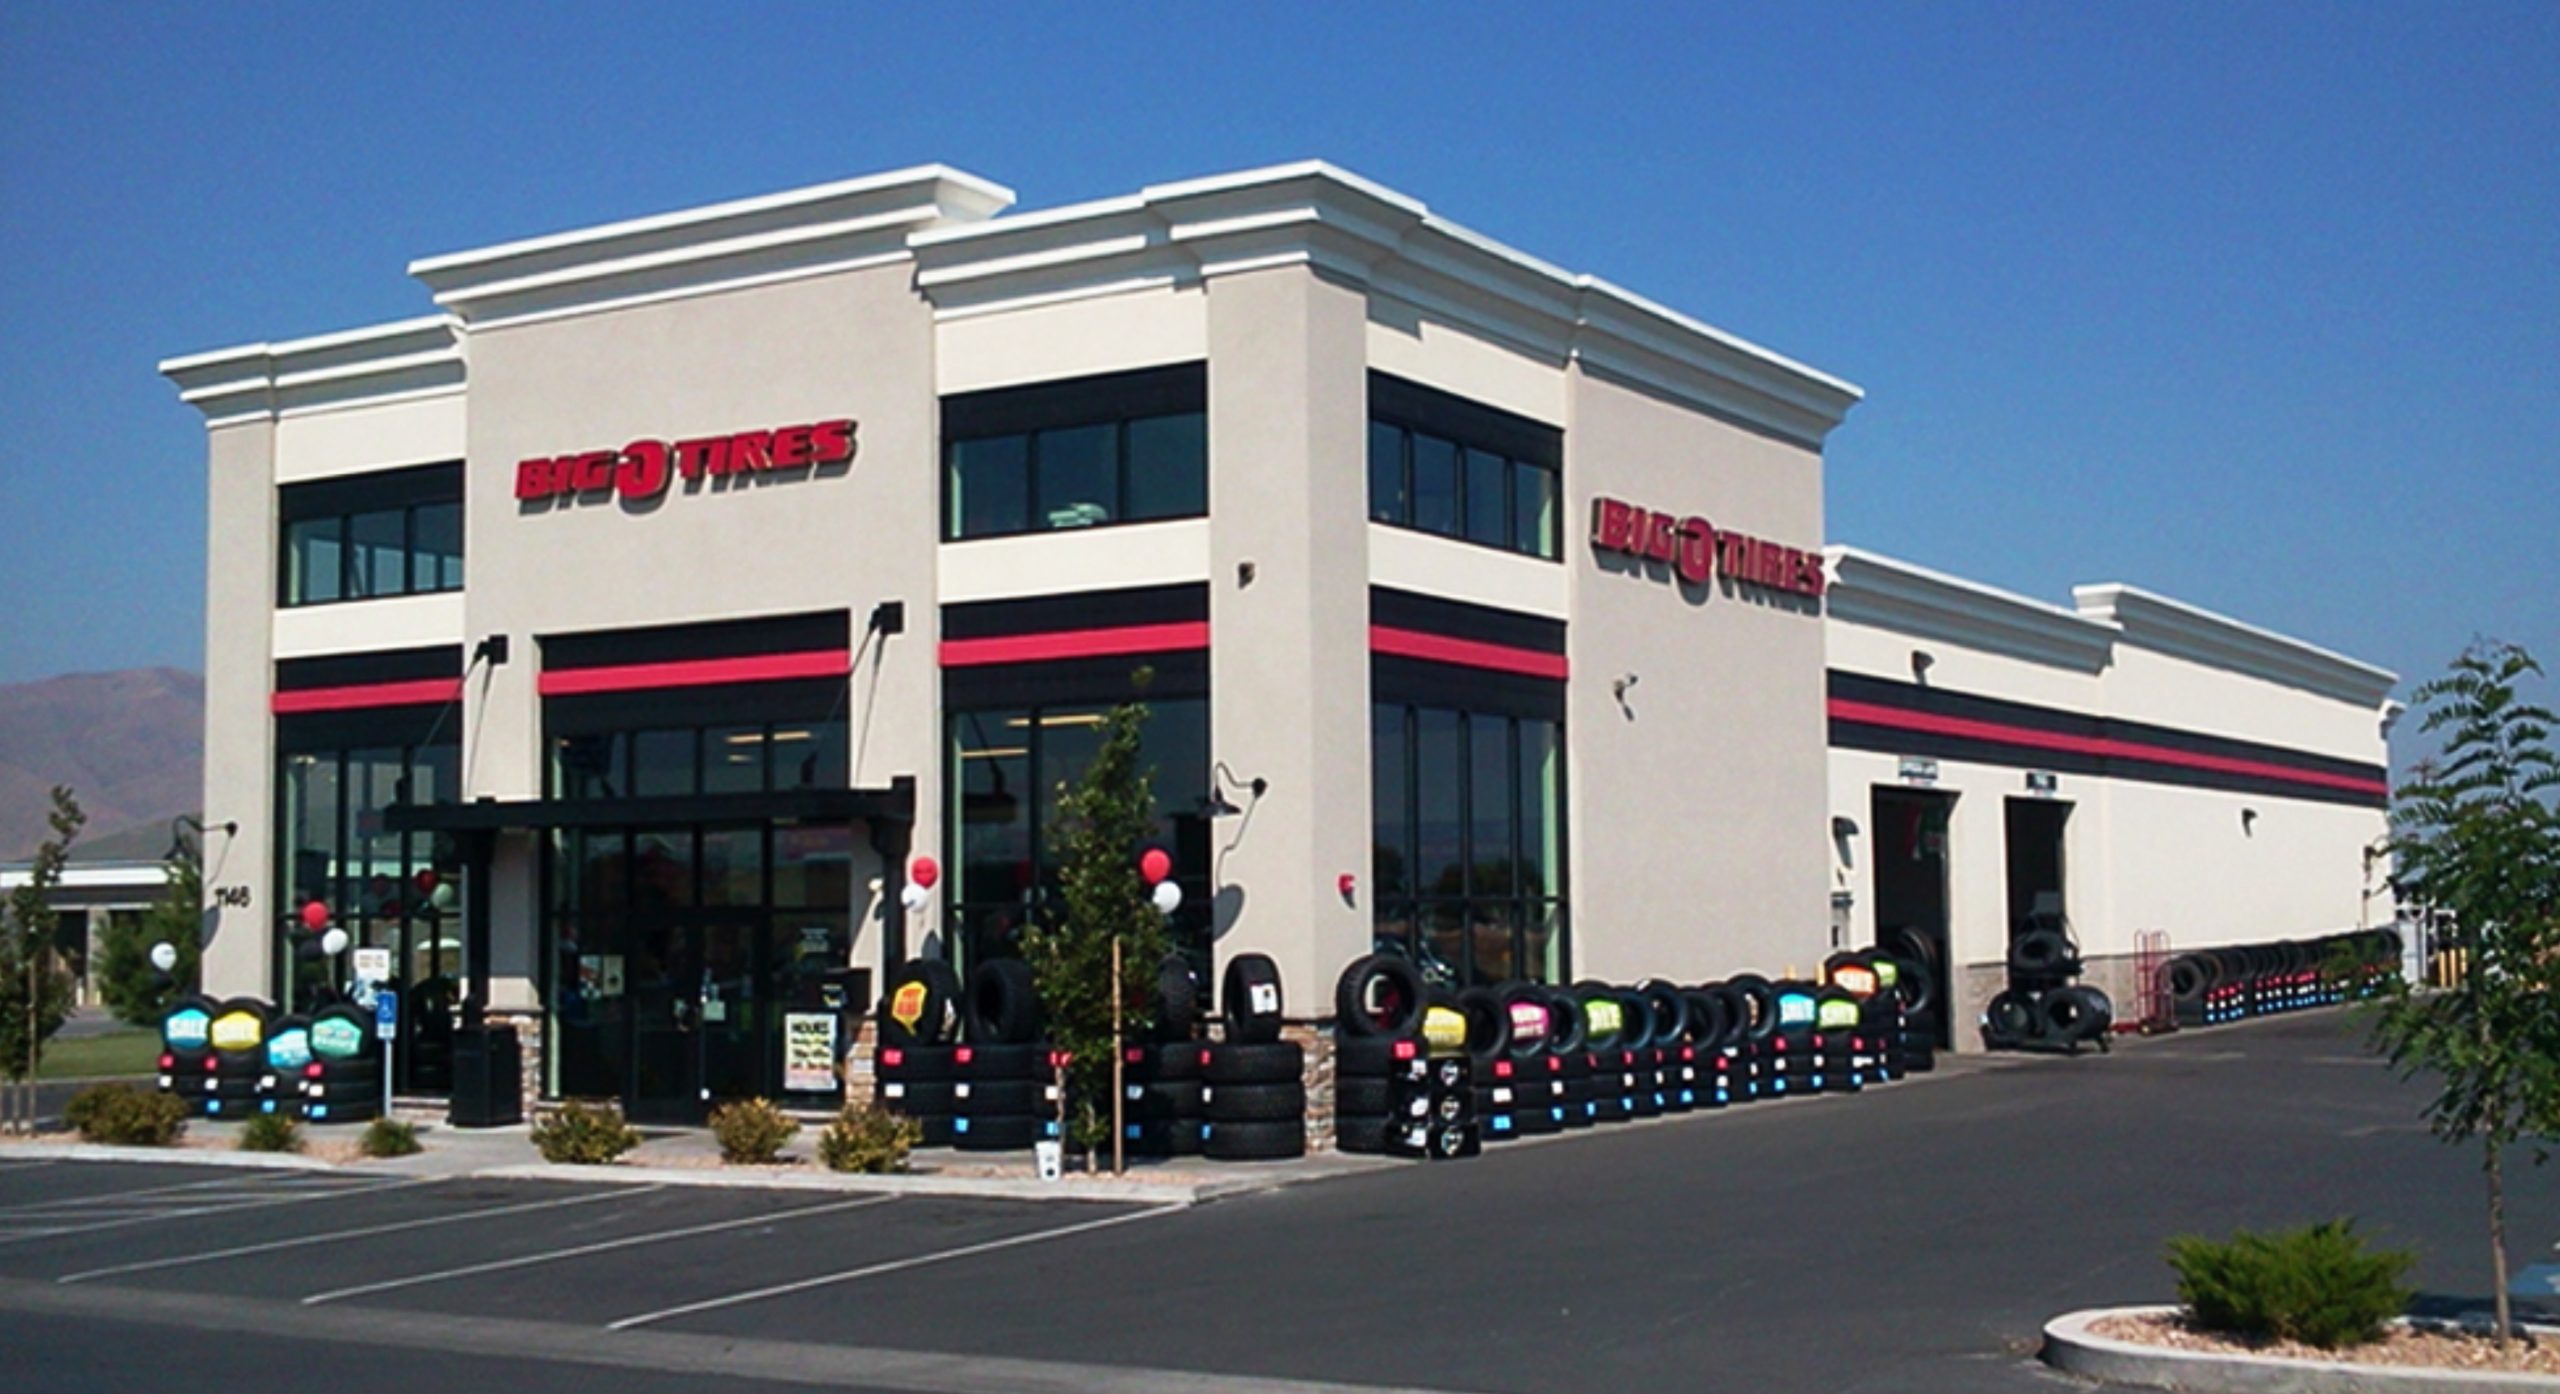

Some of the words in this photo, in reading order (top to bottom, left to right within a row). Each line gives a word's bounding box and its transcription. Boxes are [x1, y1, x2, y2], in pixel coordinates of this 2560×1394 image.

[515, 451, 617, 499] BIG
[614, 439, 674, 498] O
[676, 419, 857, 478] TIRES
[1593, 497, 1675, 562] BIG
[1715, 529, 1825, 597] TIRES
